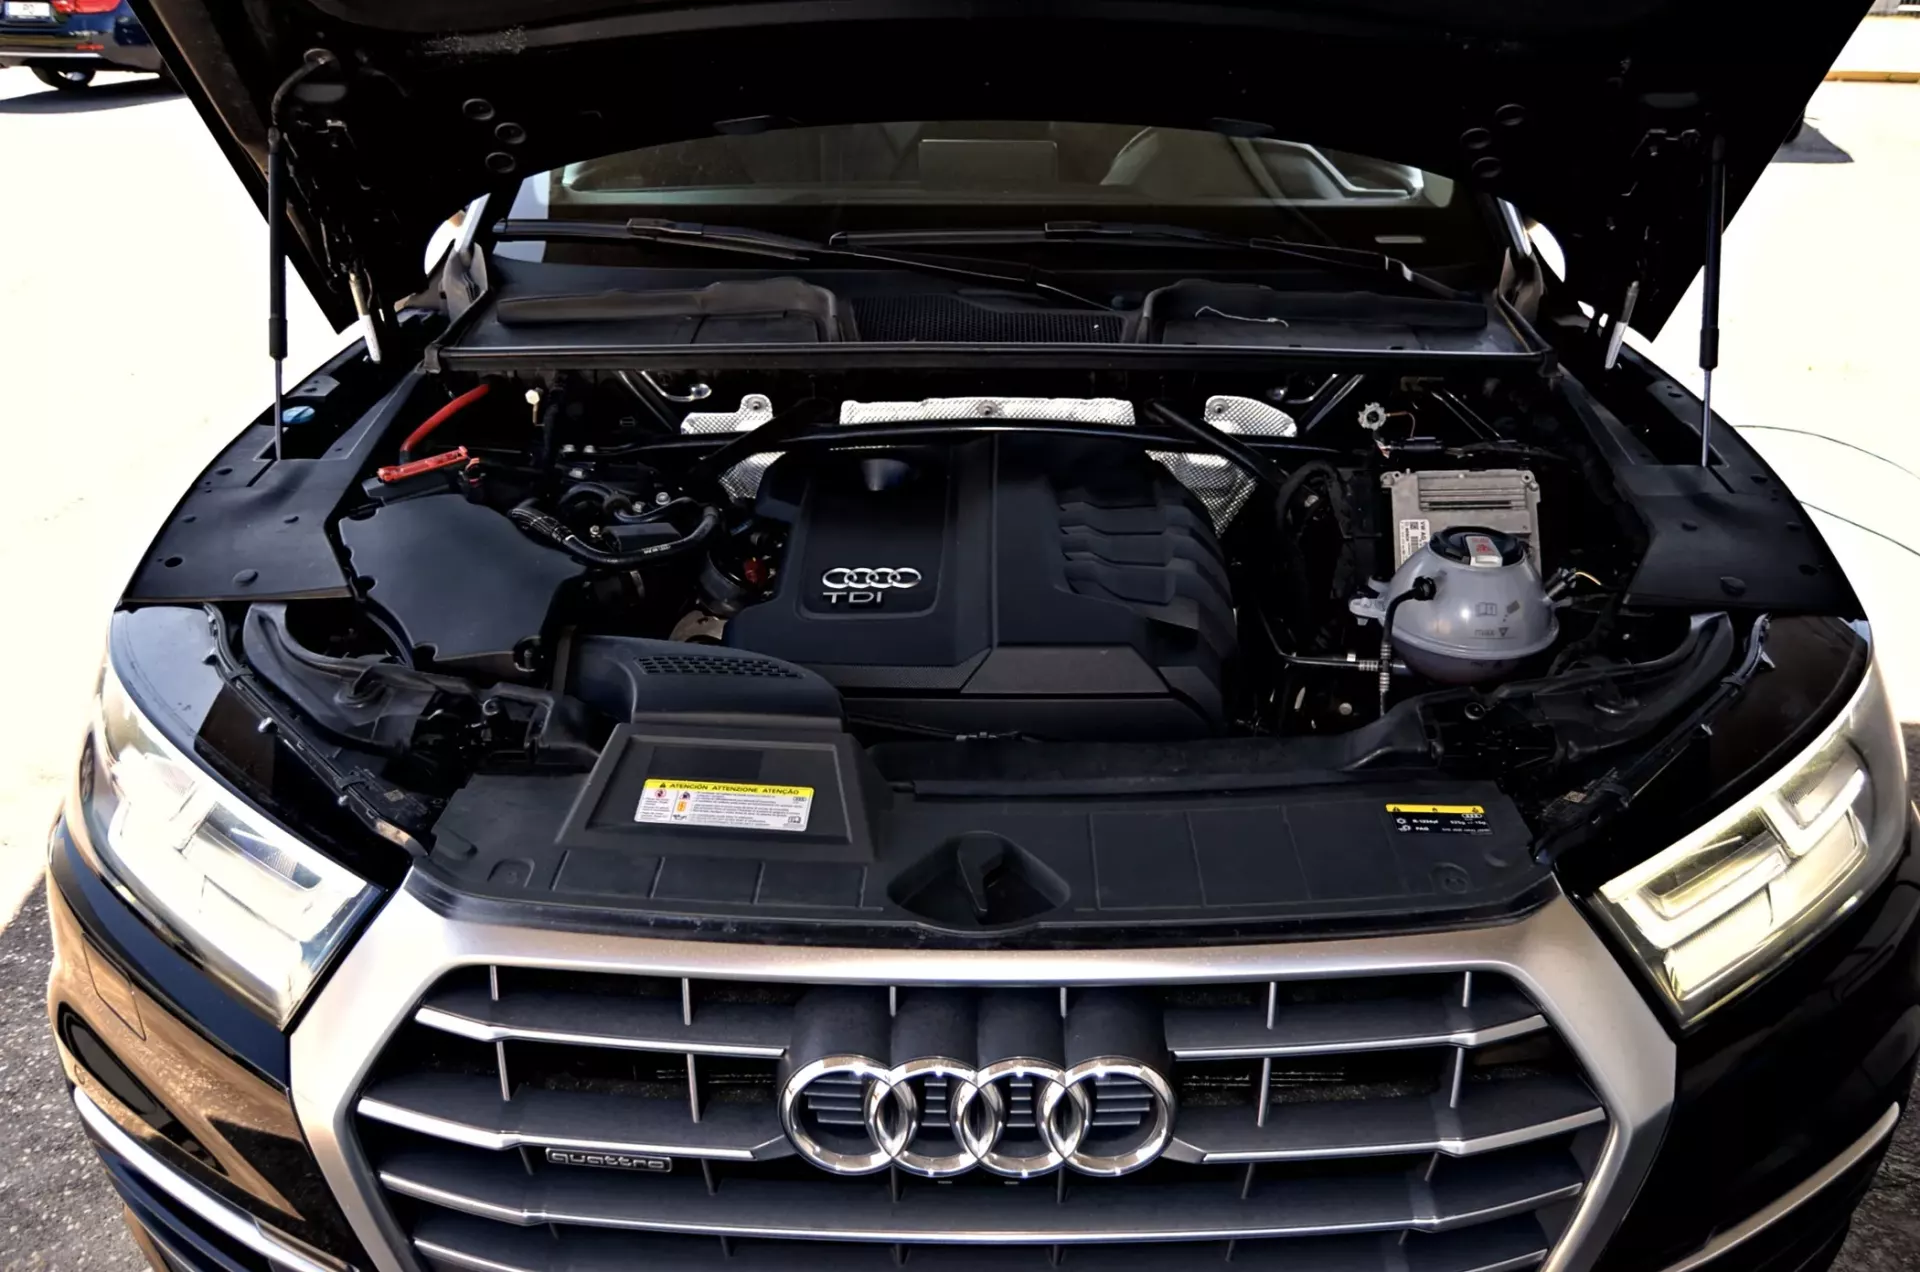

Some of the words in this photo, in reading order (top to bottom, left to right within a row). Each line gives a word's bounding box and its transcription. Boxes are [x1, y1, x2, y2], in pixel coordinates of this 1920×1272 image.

[822, 591, 882, 604] TDI
[670, 782, 708, 791] ATENCIÓN
[712, 785, 758, 793] ATTENZIONE
[763, 787, 800, 796] ATENÇÃO
[551, 1152, 665, 1169] quattro
